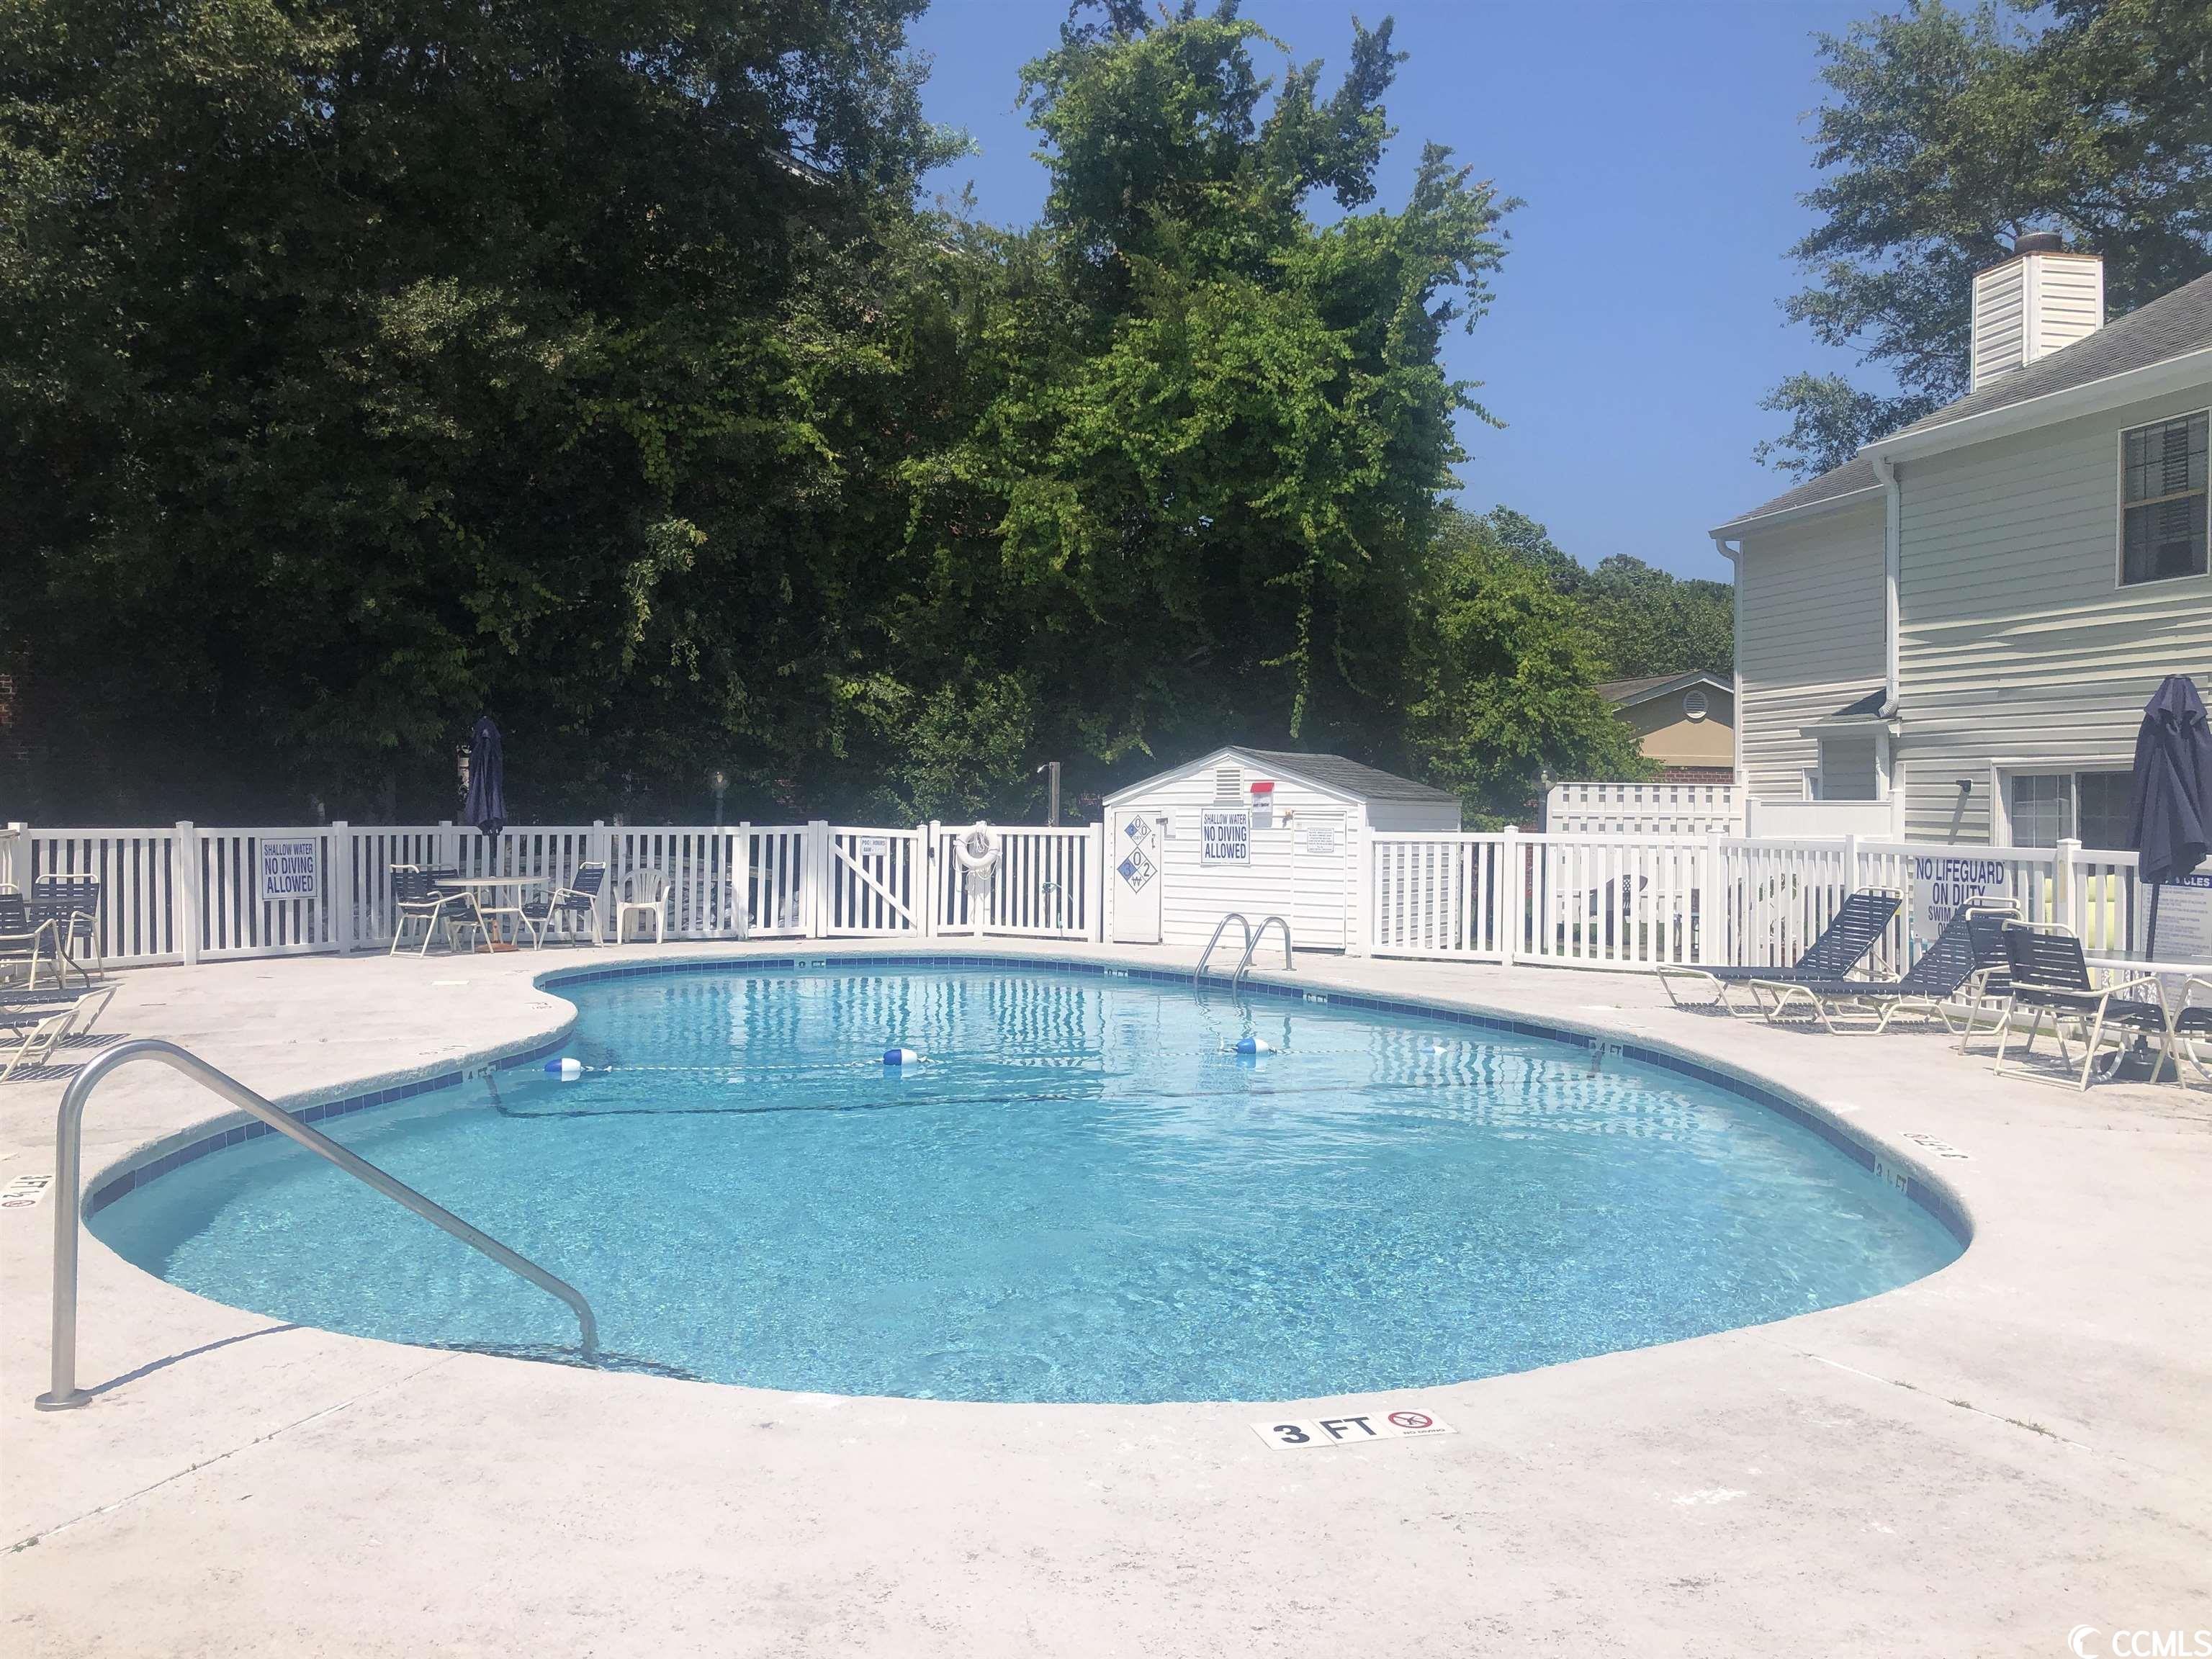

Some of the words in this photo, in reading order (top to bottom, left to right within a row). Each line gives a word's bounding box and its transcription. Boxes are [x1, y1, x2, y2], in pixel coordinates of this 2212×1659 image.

[1204, 814, 1228, 824] SHALLOW
[1229, 814, 1246, 824] WATER
[1204, 826, 1215, 842] NO
[1218, 826, 1246, 842] DIVING
[264, 844, 292, 855] SHALLOW
[293, 843, 313, 855] WATER
[1205, 842, 1246, 858] ALLOWED
[265, 858, 278, 875] NO
[282, 856, 313, 874] DIVING
[1916, 858, 1933, 880] NO
[1936, 859, 2005, 884] LIFEGUARD
[267, 876, 313, 893] ALLOWED
[2175, 876, 2210, 887] ULES
[1933, 882, 1948, 906] ON
[1928, 906, 1951, 921] SWIM
[1273, 1425, 1310, 1443] 3
[1319, 1416, 1377, 1439] FT
